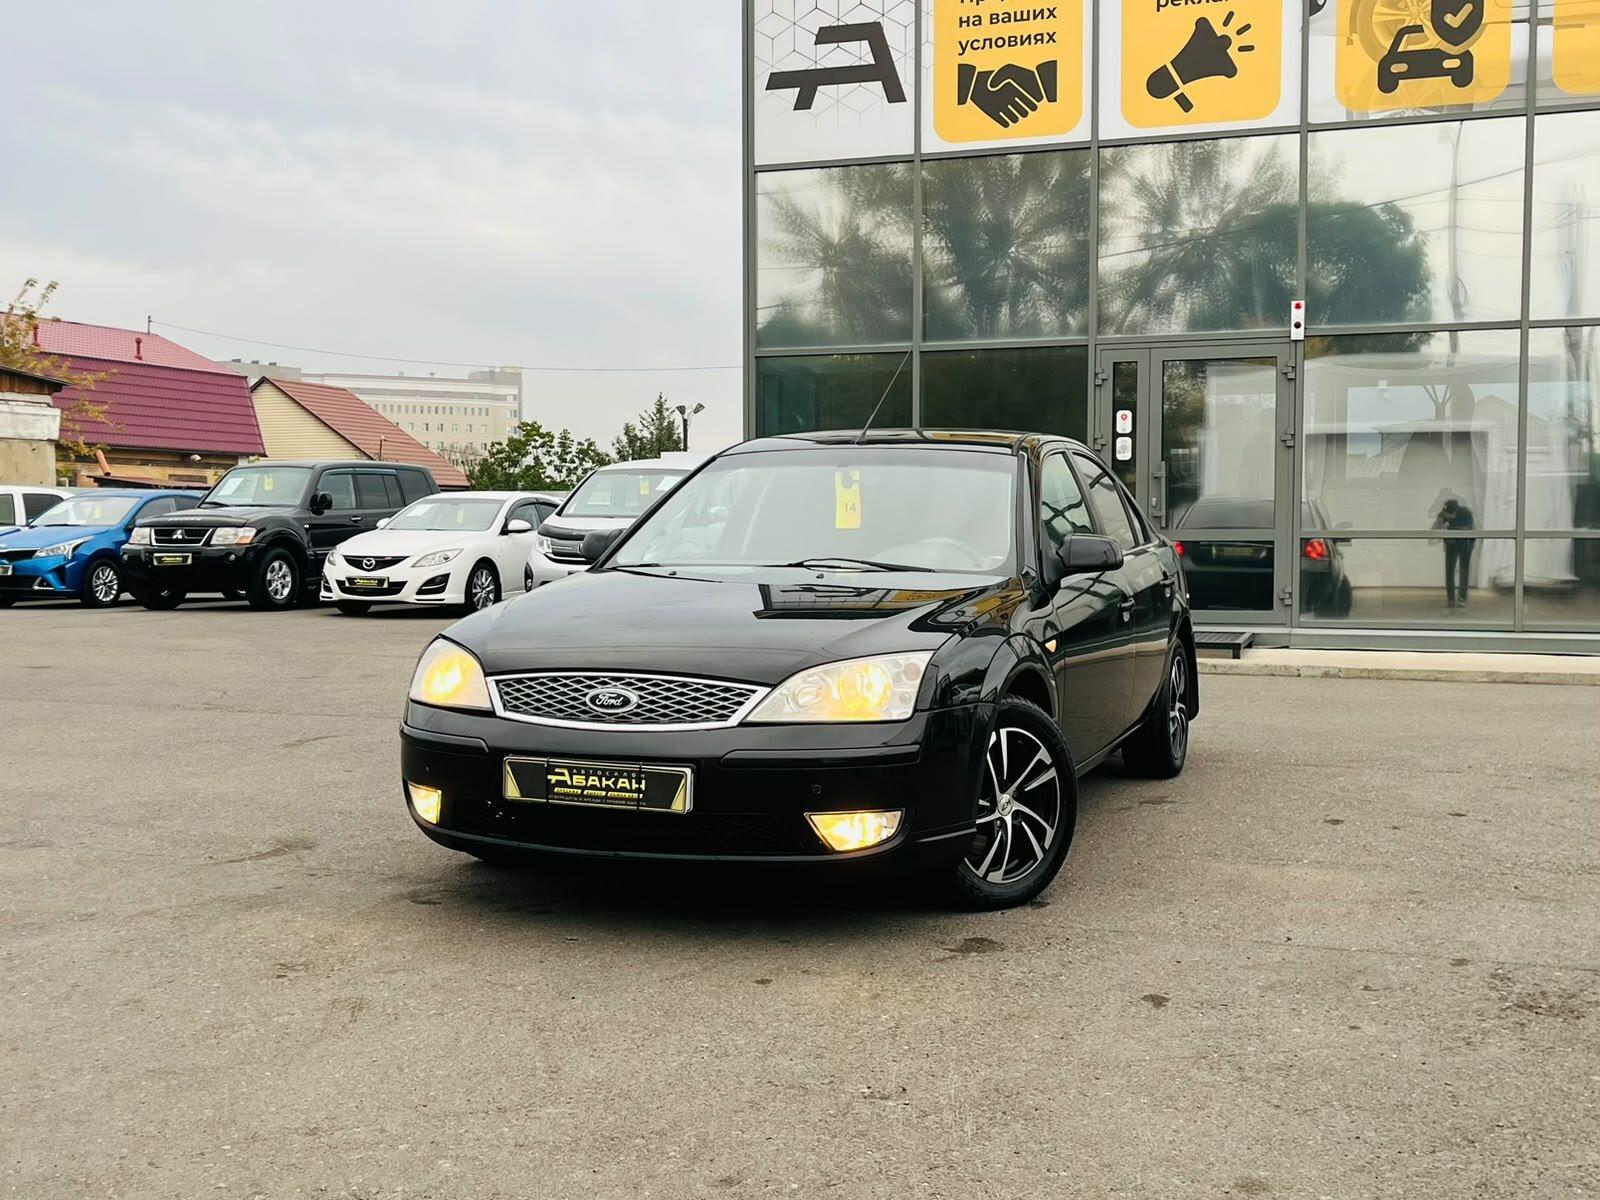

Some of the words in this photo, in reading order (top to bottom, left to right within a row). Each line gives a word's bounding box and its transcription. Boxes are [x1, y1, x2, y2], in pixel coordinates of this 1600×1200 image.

[958, 14, 983, 28] на
[989, 6, 1058, 25] ваших
[958, 31, 1057, 56] условиях
[595, 693, 624, 706] Ford
